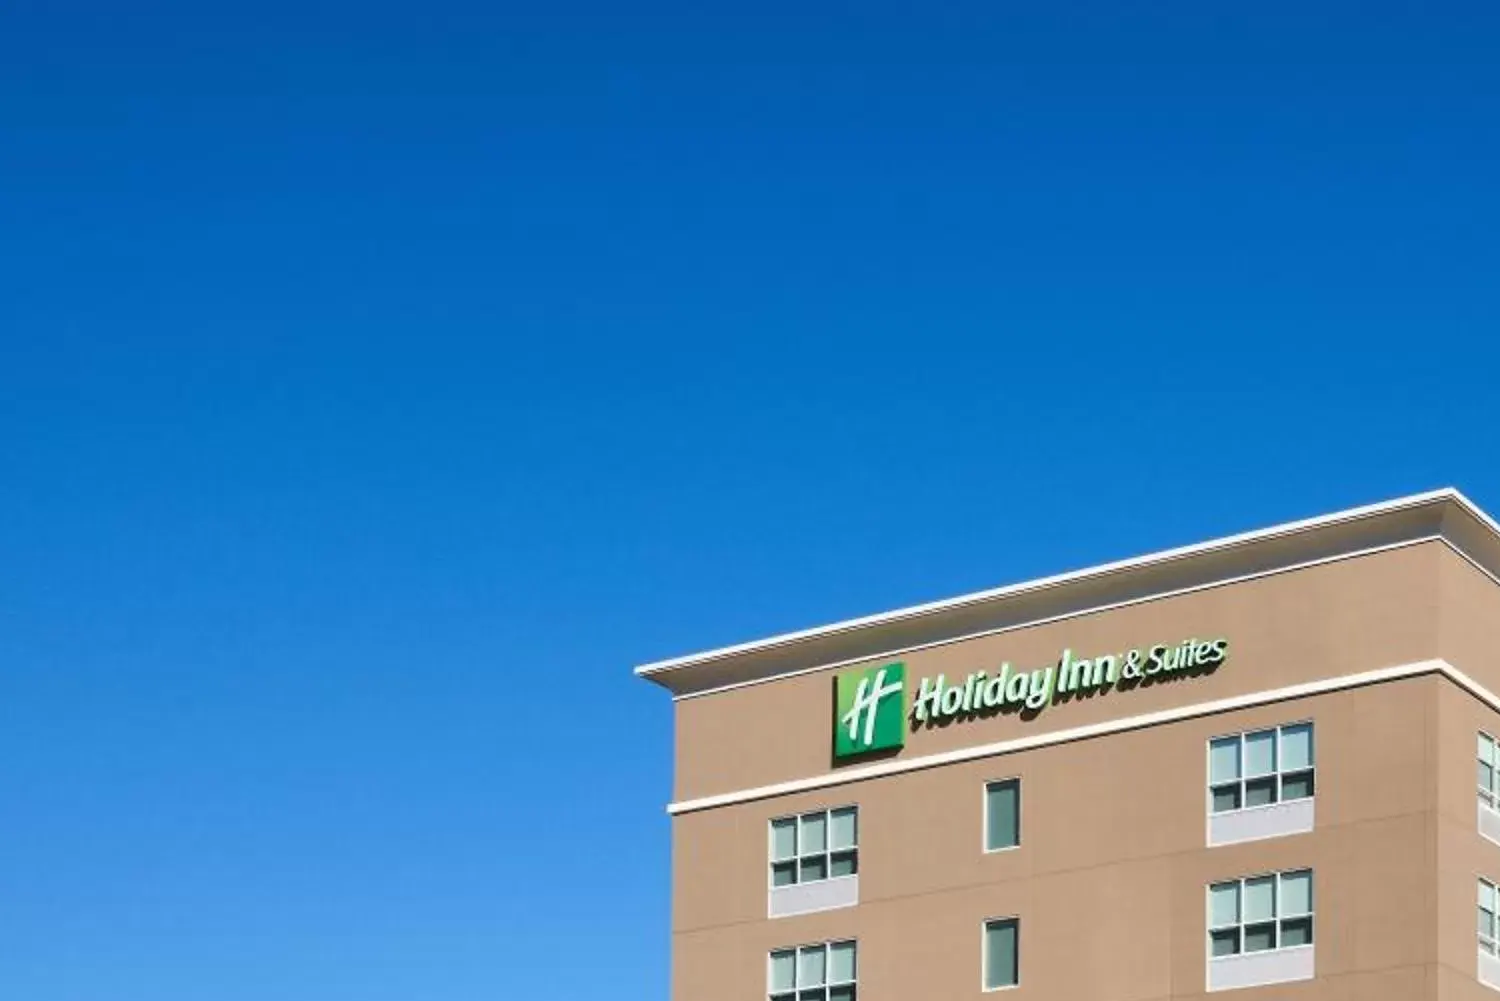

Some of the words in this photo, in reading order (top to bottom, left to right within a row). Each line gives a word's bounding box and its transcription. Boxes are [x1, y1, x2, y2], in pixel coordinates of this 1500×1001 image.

[842, 669, 903, 745] H
[914, 663, 1053, 721] Holiday
[1057, 649, 1115, 693] Inn
[1122, 649, 1141, 679] &
[1147, 637, 1226, 675] Suites
